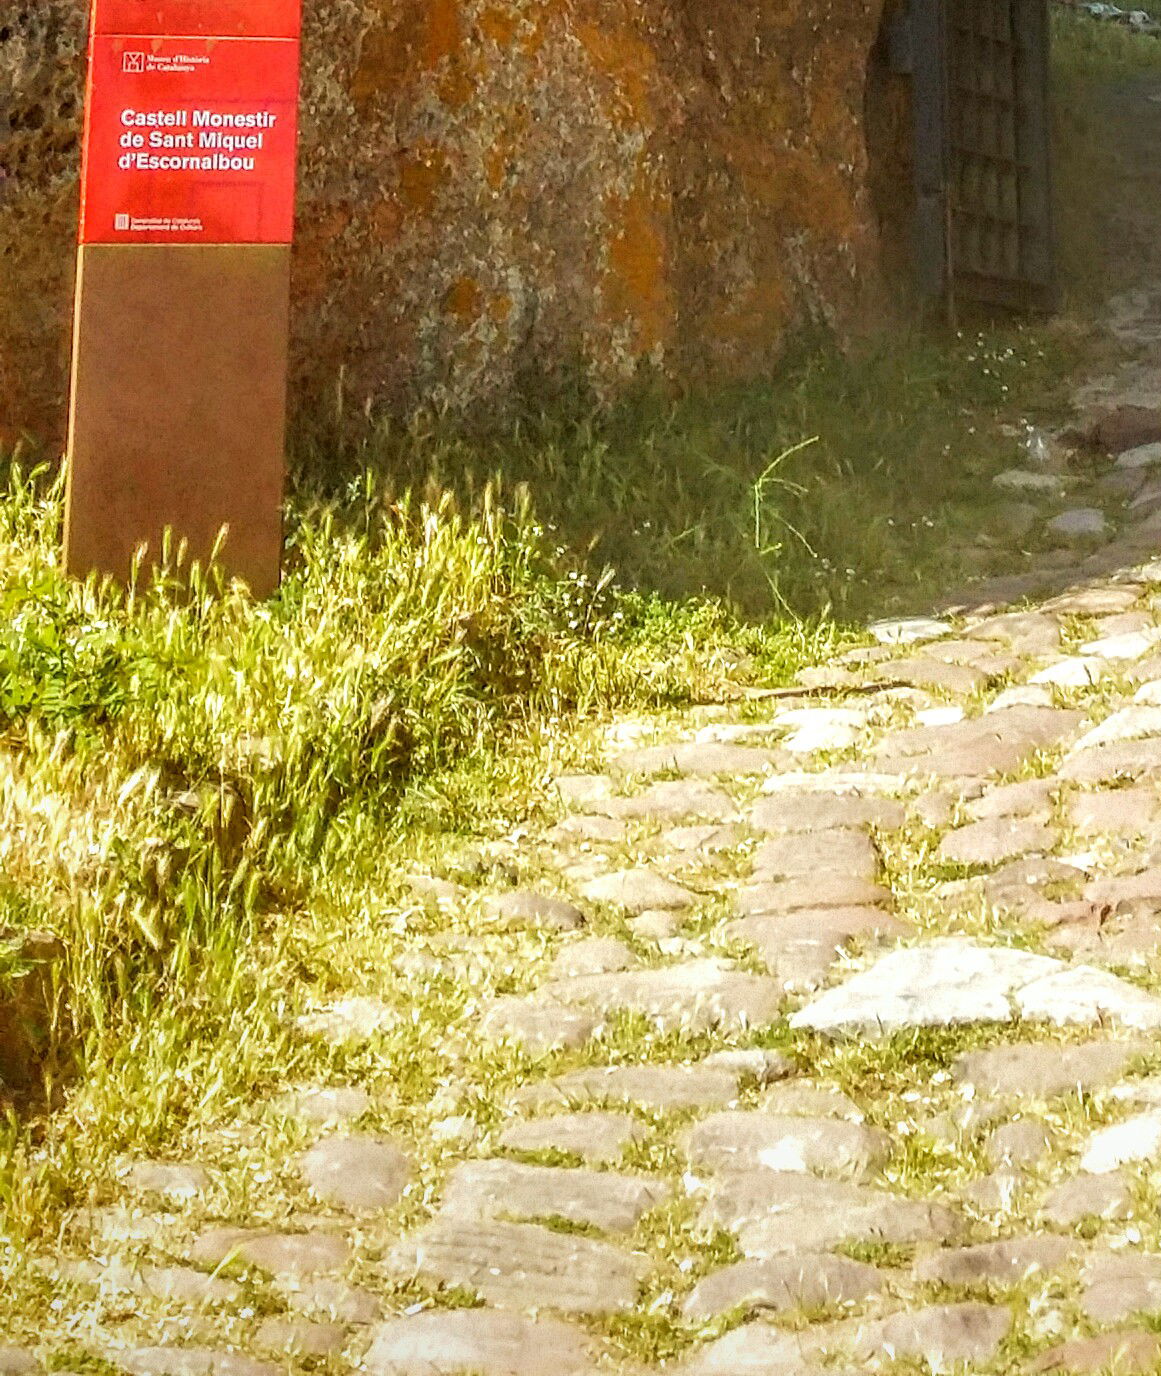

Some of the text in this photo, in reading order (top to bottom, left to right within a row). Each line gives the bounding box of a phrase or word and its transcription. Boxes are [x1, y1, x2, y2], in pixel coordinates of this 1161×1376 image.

[146, 63, 196, 72] de Catalunya
[120, 109, 277, 128] Castell Monestir
[119, 131, 263, 152] de Sant Miquel
[118, 152, 255, 170] d'Escornalbou
